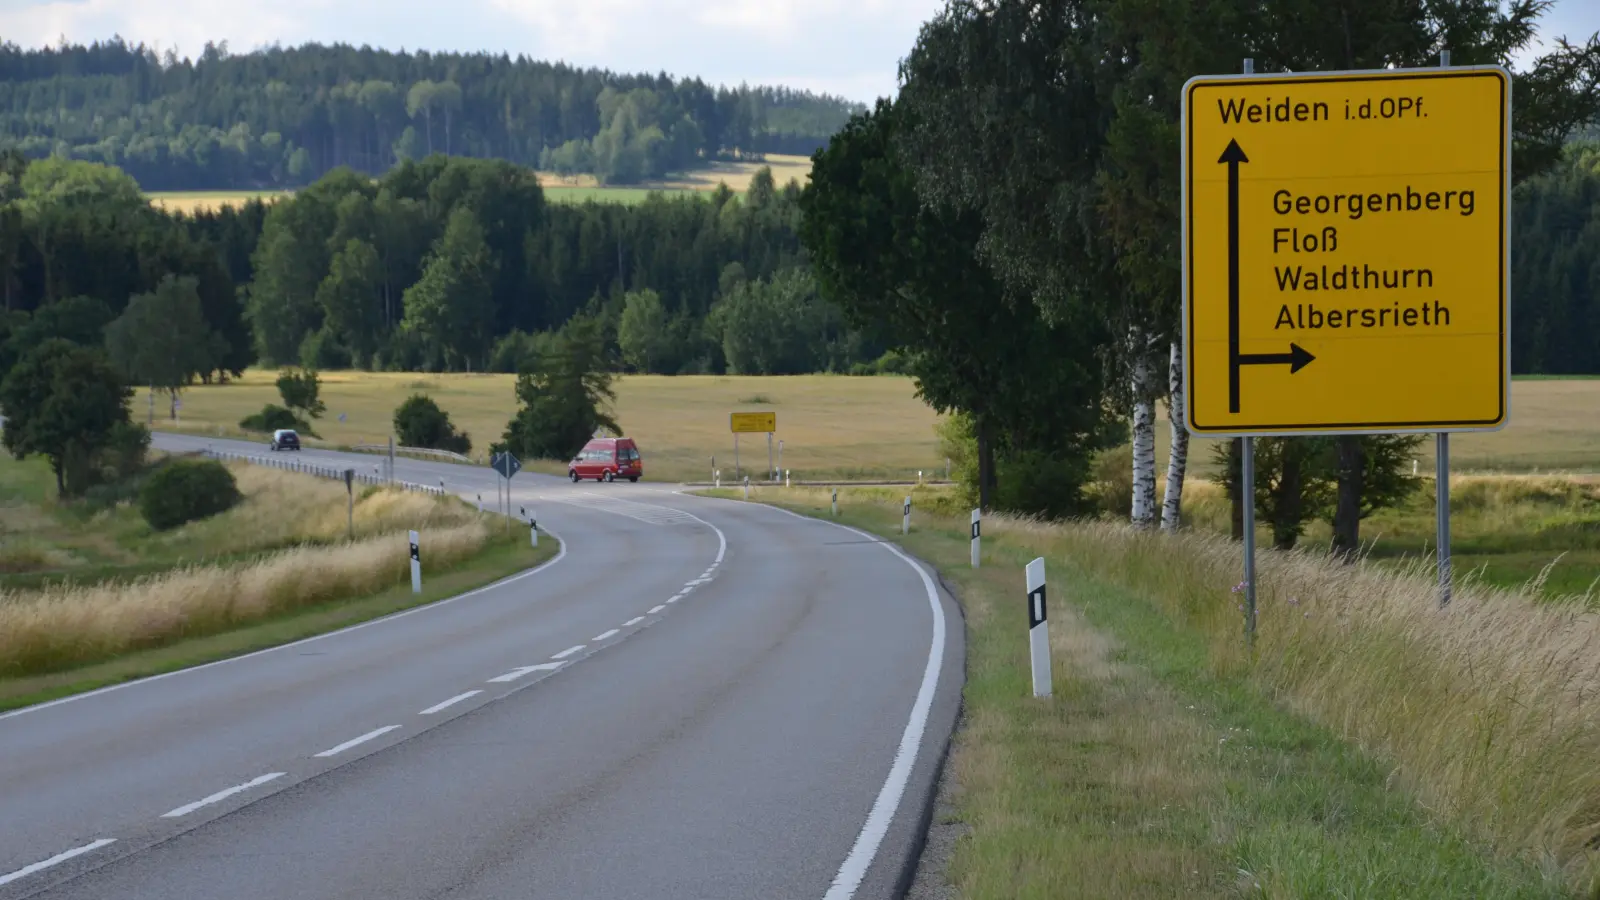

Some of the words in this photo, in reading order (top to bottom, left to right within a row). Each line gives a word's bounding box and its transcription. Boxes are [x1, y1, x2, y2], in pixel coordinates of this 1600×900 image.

[1217, 97, 1328, 125] Weiden
[1345, 96, 1427, 120] i.d.OPf.
[1273, 186, 1475, 219] Georgenberg
[1273, 227, 1338, 254] Floß
[1274, 264, 1433, 292] Waldthurn
[1274, 301, 1450, 330] Albersrieth
